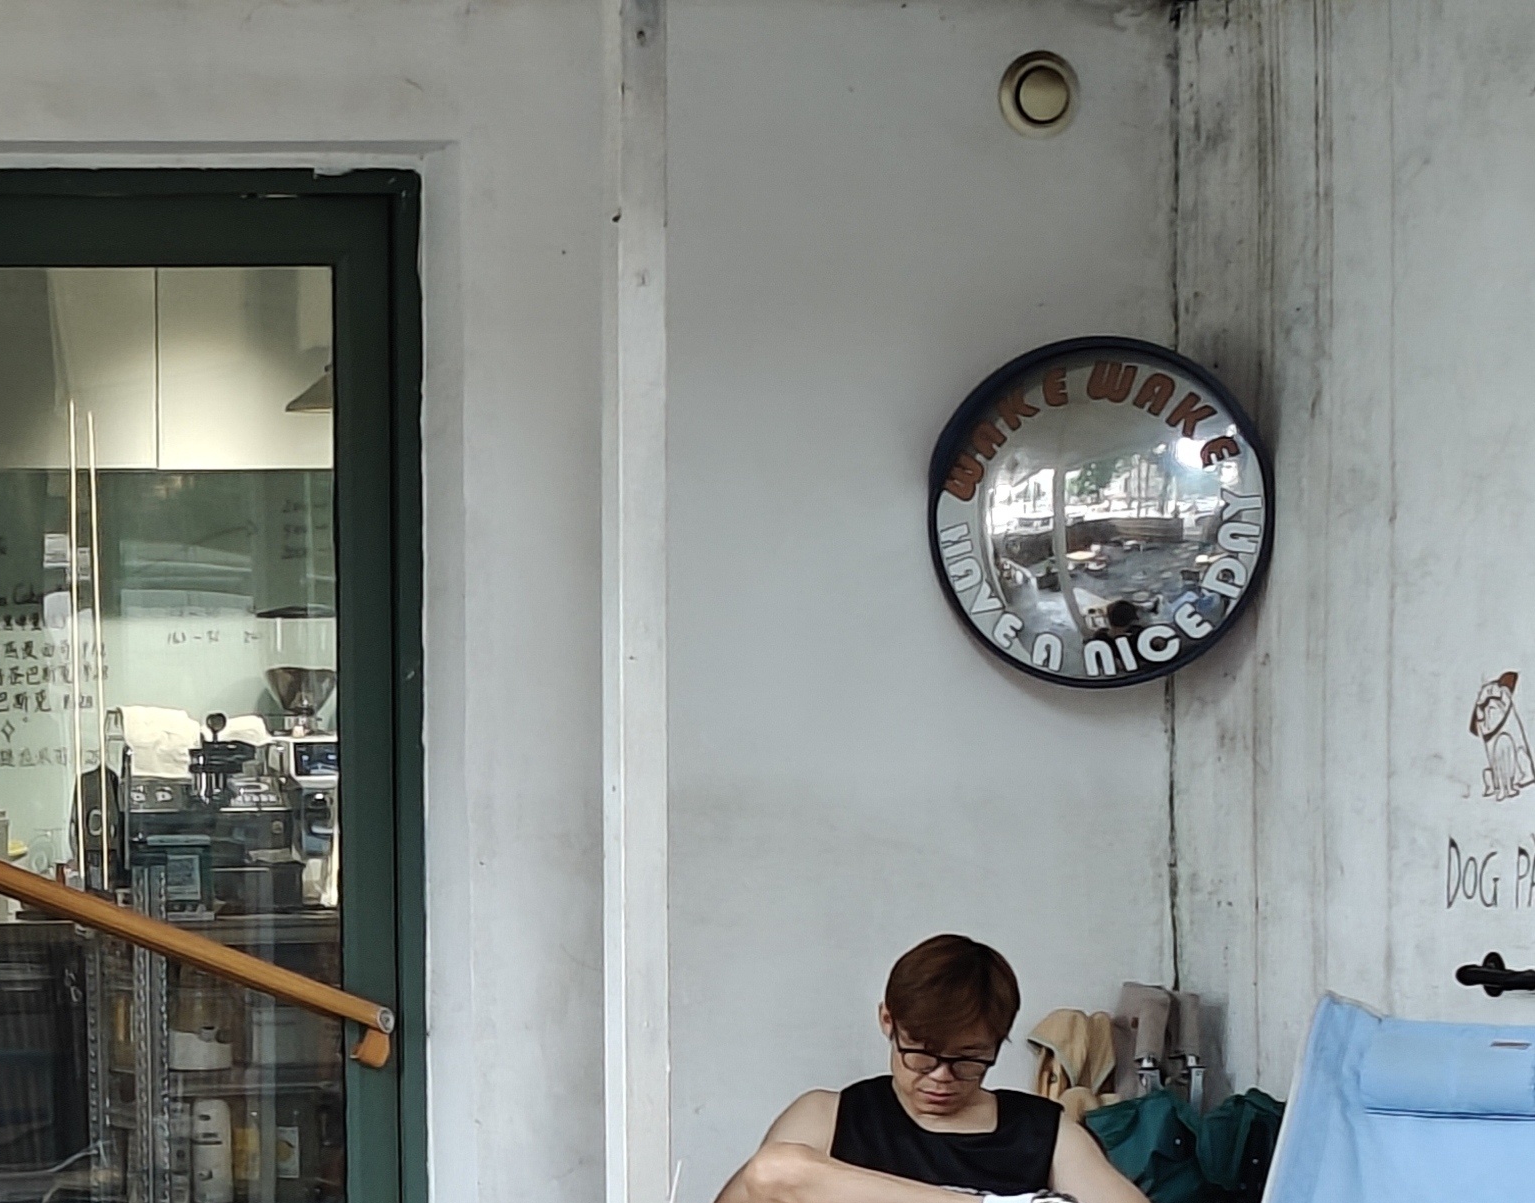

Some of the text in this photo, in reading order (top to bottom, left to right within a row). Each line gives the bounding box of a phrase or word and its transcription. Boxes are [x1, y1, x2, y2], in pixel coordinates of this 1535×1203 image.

[943, 360, 1241, 502] WAKE WAKE
[940, 523, 1025, 650] HAVE
[1082, 600, 1215, 678] NICE
[1202, 488, 1264, 600] DAY
[1446, 835, 1500, 909] DOG
